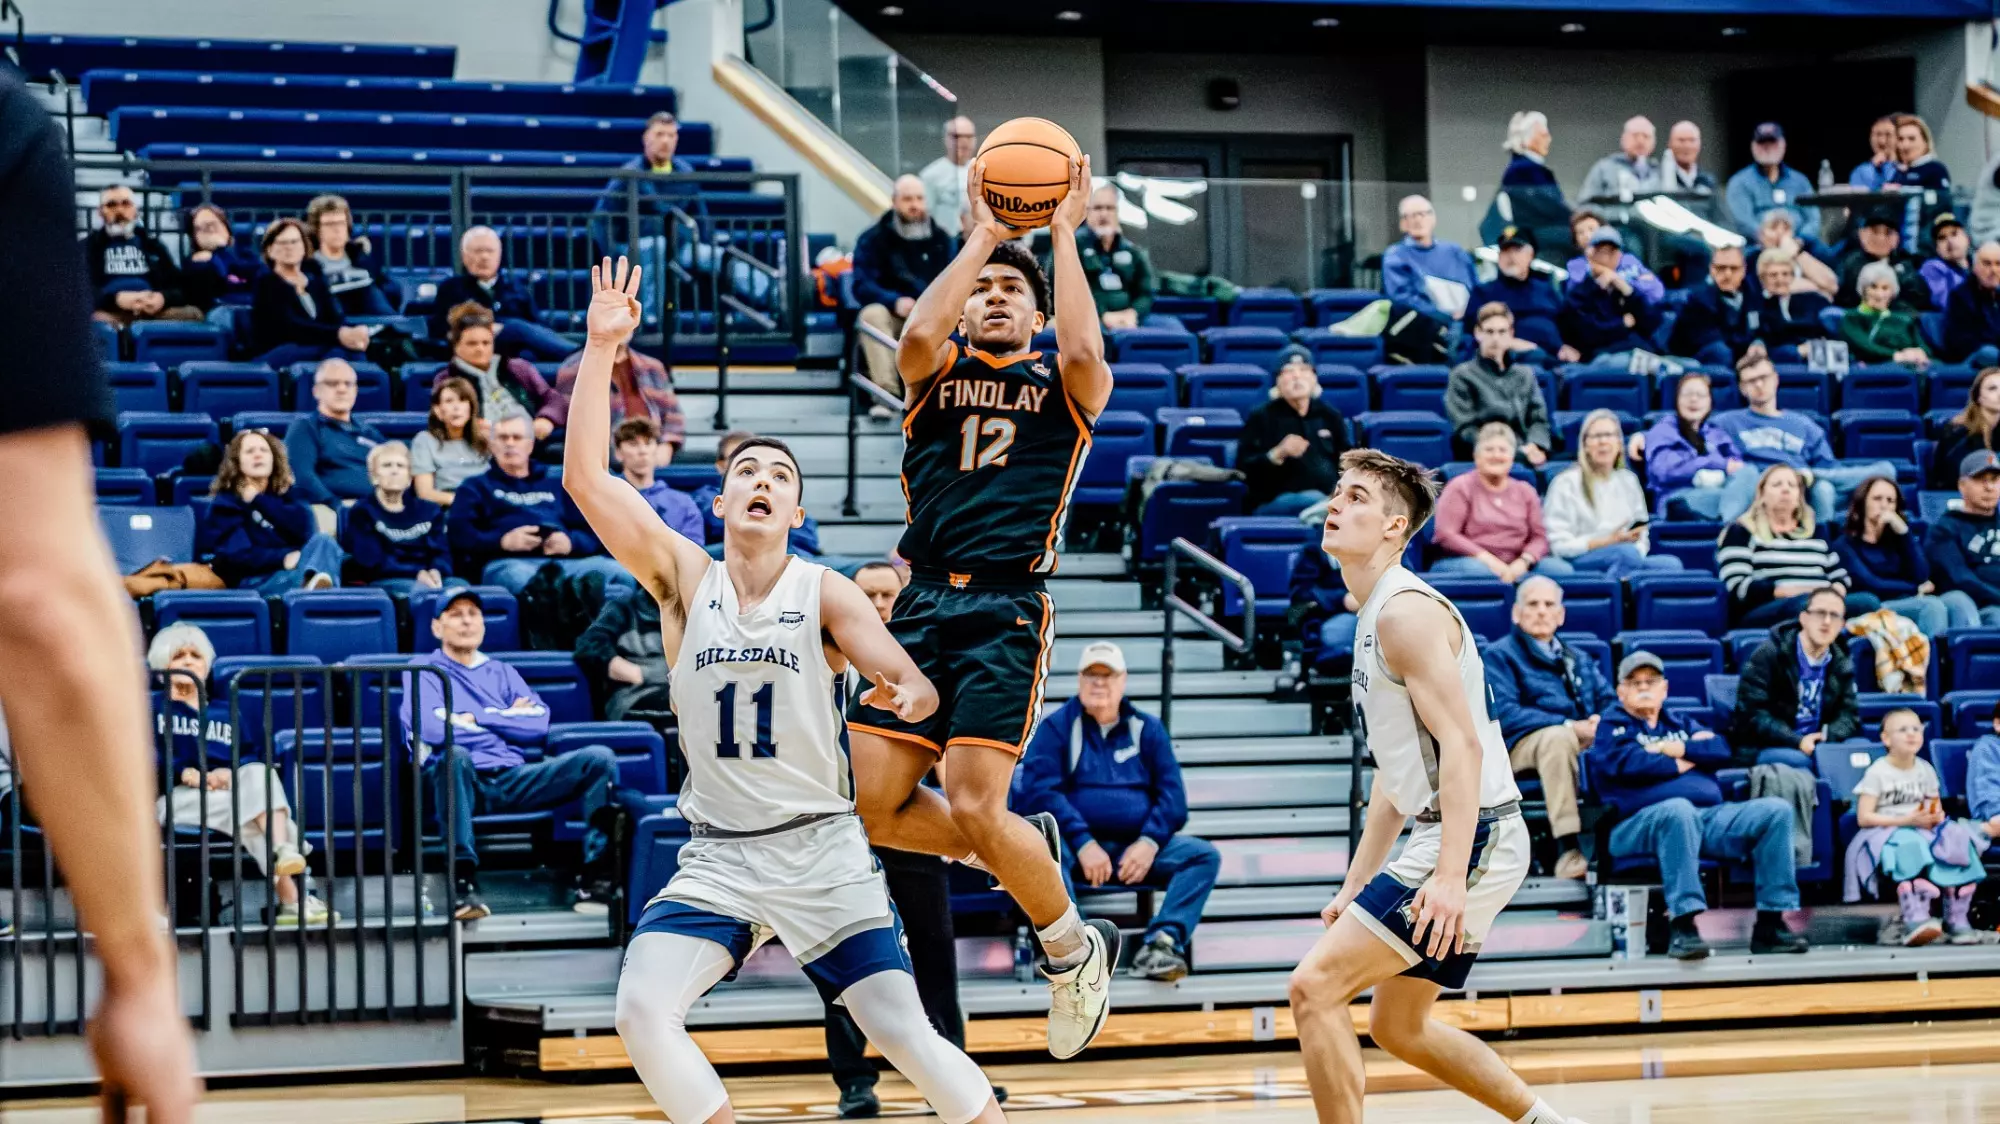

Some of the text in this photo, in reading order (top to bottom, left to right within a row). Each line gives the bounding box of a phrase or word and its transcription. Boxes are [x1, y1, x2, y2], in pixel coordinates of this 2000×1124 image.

[986, 187, 1058, 213] Wilson
[939, 379, 1049, 413] FINDLAY
[960, 414, 1017, 471] 12
[695, 646, 800, 674] HILLSDALE
[714, 680, 778, 760] 11
